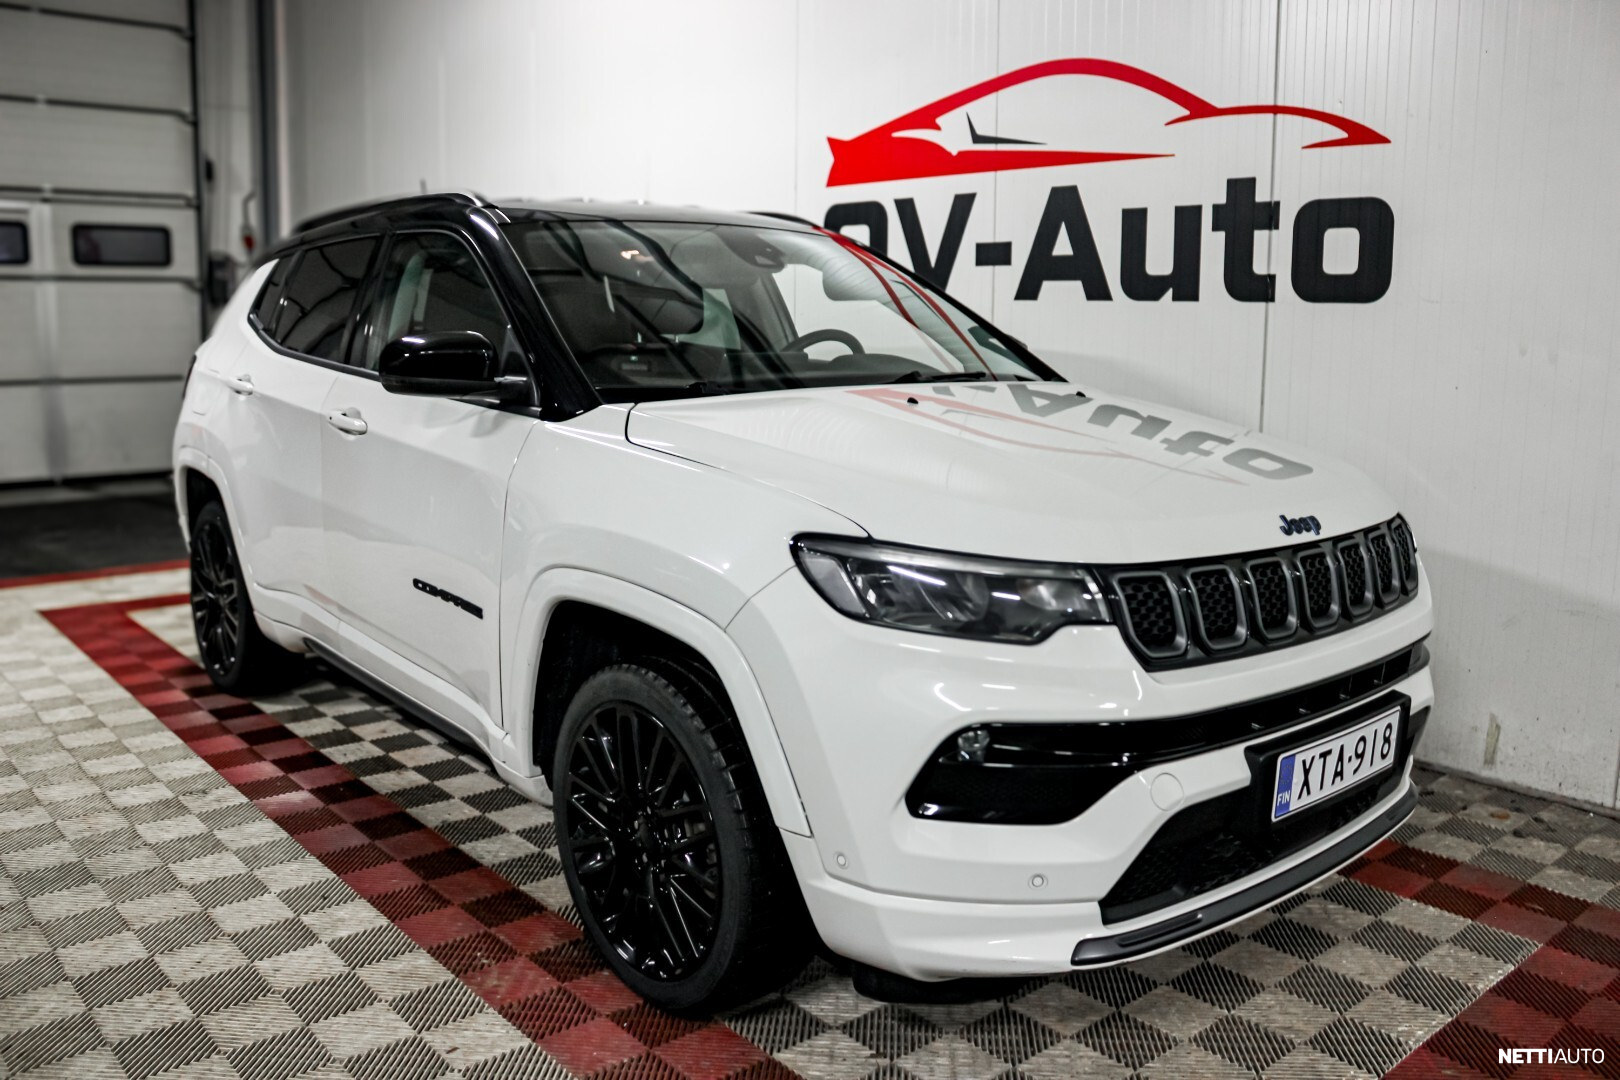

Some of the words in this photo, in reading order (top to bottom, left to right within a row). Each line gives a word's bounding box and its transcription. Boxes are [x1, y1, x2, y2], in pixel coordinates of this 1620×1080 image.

[1279, 514, 1321, 536] Jeep
[1277, 790, 1291, 806] FIN
[1297, 722, 1393, 801] XTA-918
